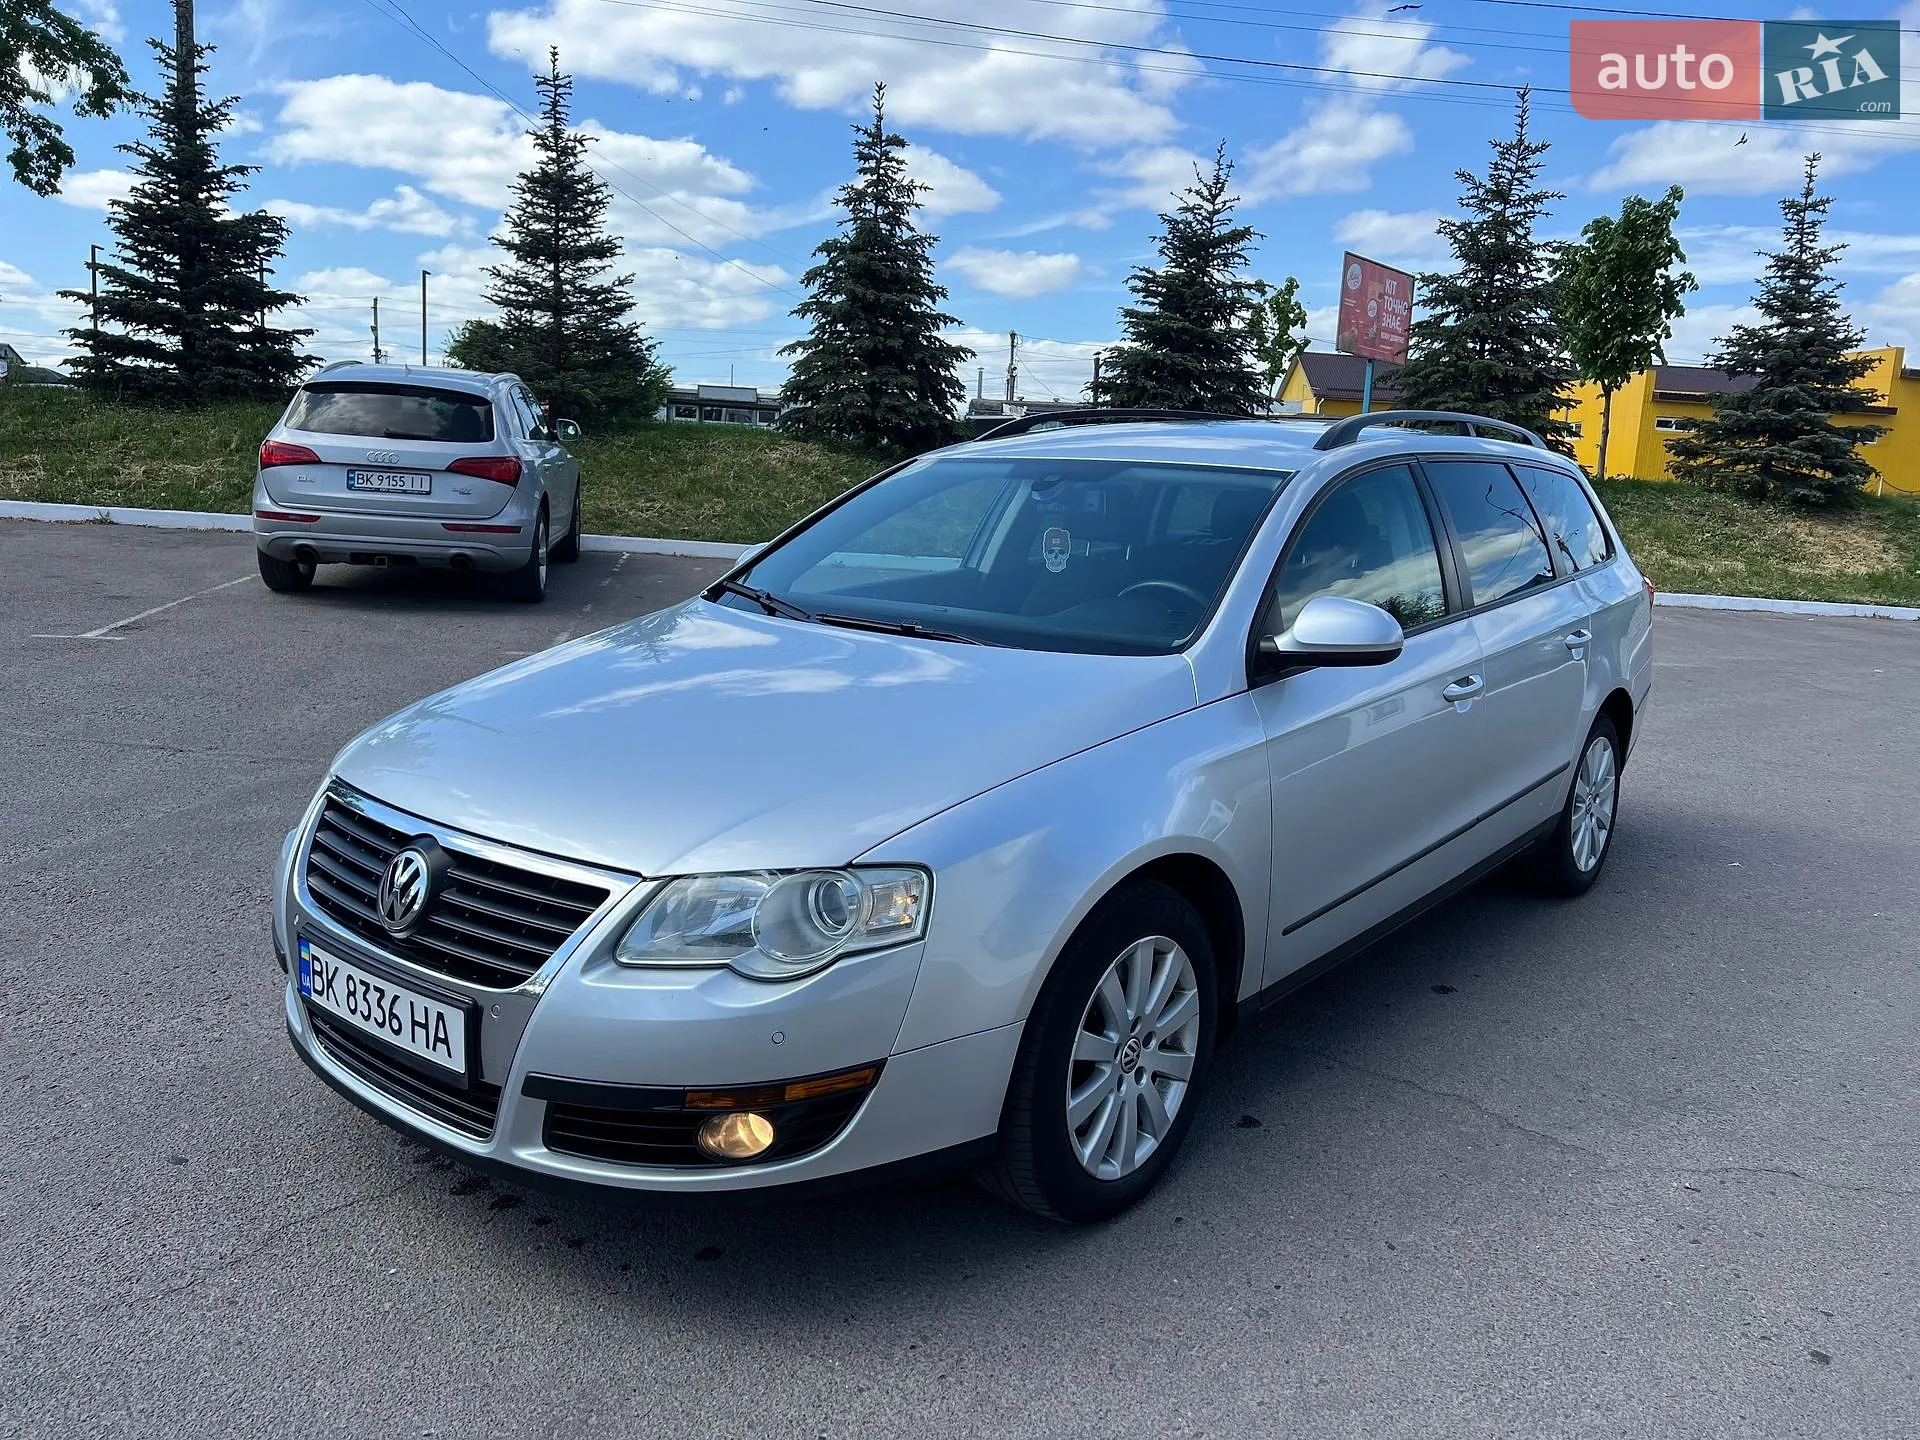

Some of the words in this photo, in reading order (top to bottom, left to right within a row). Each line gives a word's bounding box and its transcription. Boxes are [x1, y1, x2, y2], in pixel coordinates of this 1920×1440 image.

[1384, 296, 1408, 316] ТОЧНО
[356, 473, 373, 486] BK
[377, 474, 405, 488] 9155
[302, 972, 311, 989] UA
[311, 952, 341, 1008] BK
[346, 973, 403, 1036] 8336
[409, 1000, 452, 1059] HA
